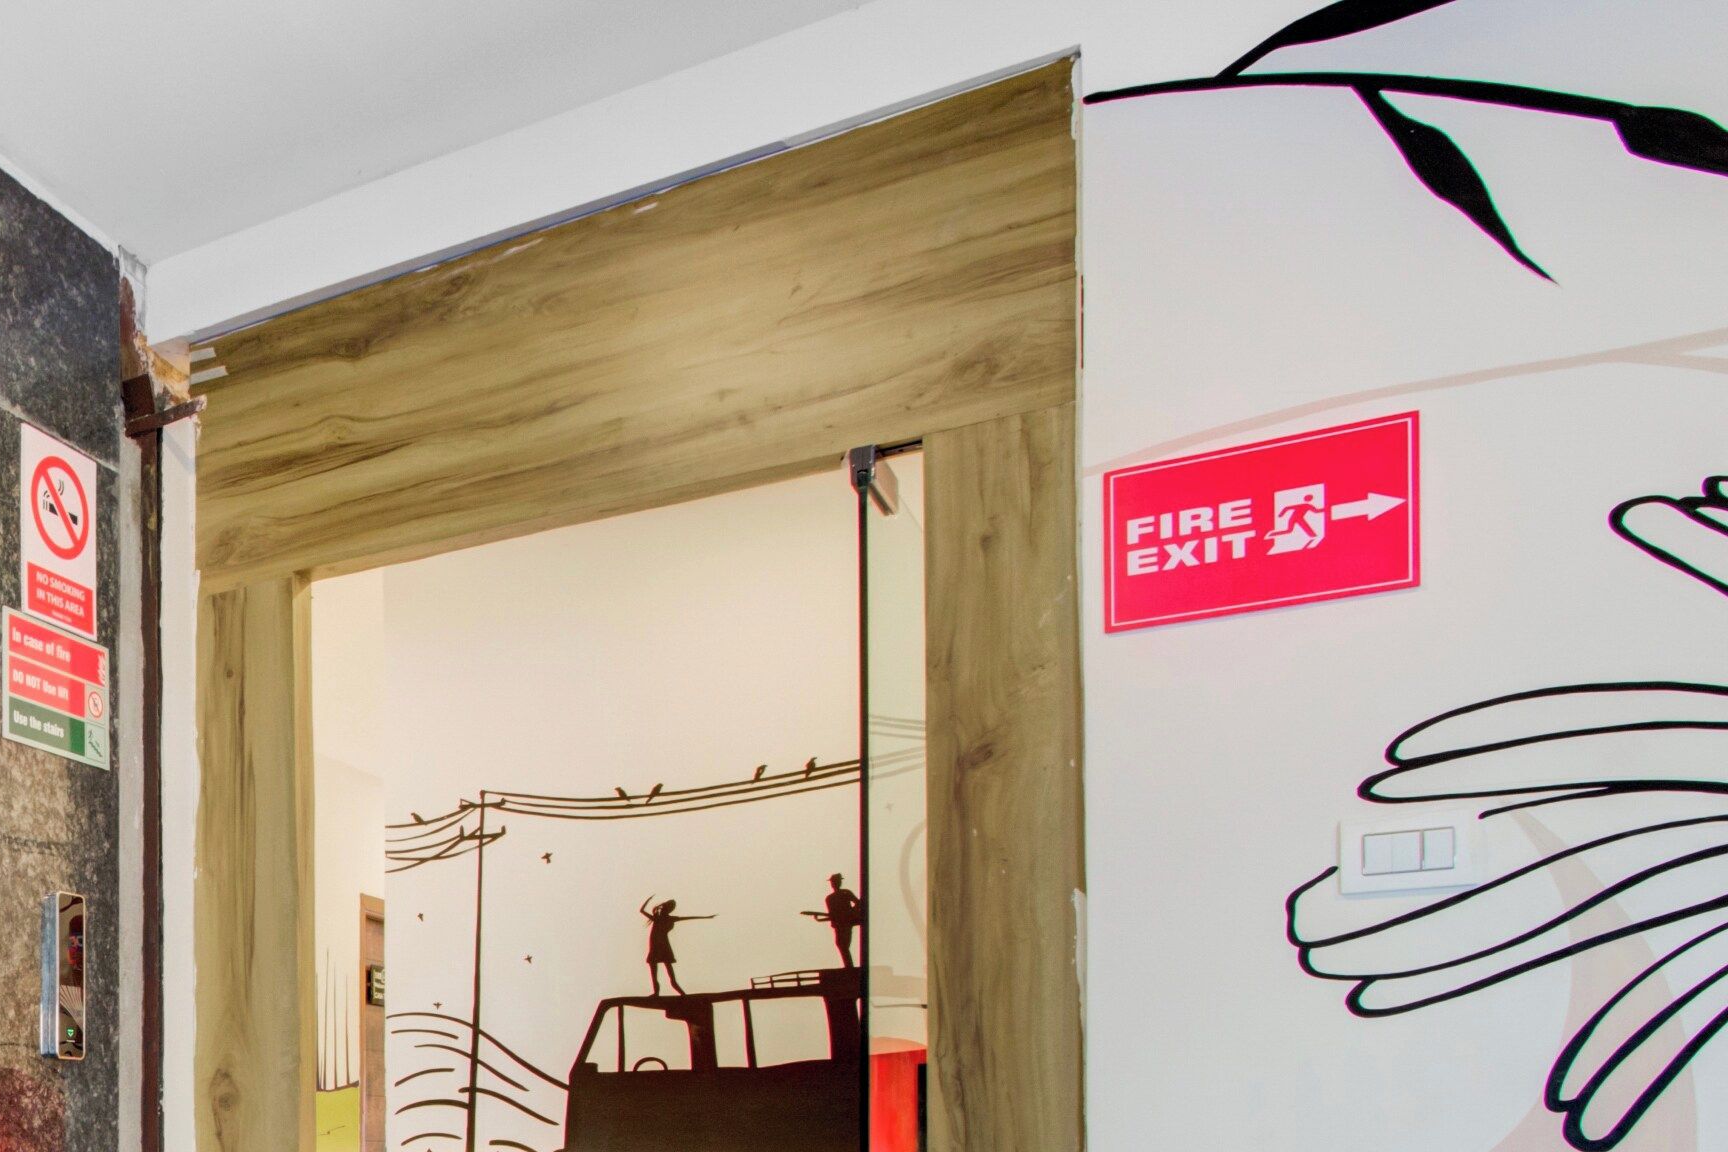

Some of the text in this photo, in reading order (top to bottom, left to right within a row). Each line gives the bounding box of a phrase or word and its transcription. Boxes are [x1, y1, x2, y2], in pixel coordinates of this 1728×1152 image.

[1126, 498, 1253, 545] FIRE
[1126, 530, 1257, 577] EXIT
[36, 571, 85, 602] NO SMOKING
[36, 588, 46, 600] IN
[46, 592, 64, 608] THIS
[65, 600, 85, 618] AREA
[13, 627, 71, 662] In case of fire
[13, 669, 24, 684] DO
[25, 673, 41, 689] NOT
[13, 709, 65, 738] Use the stairs
